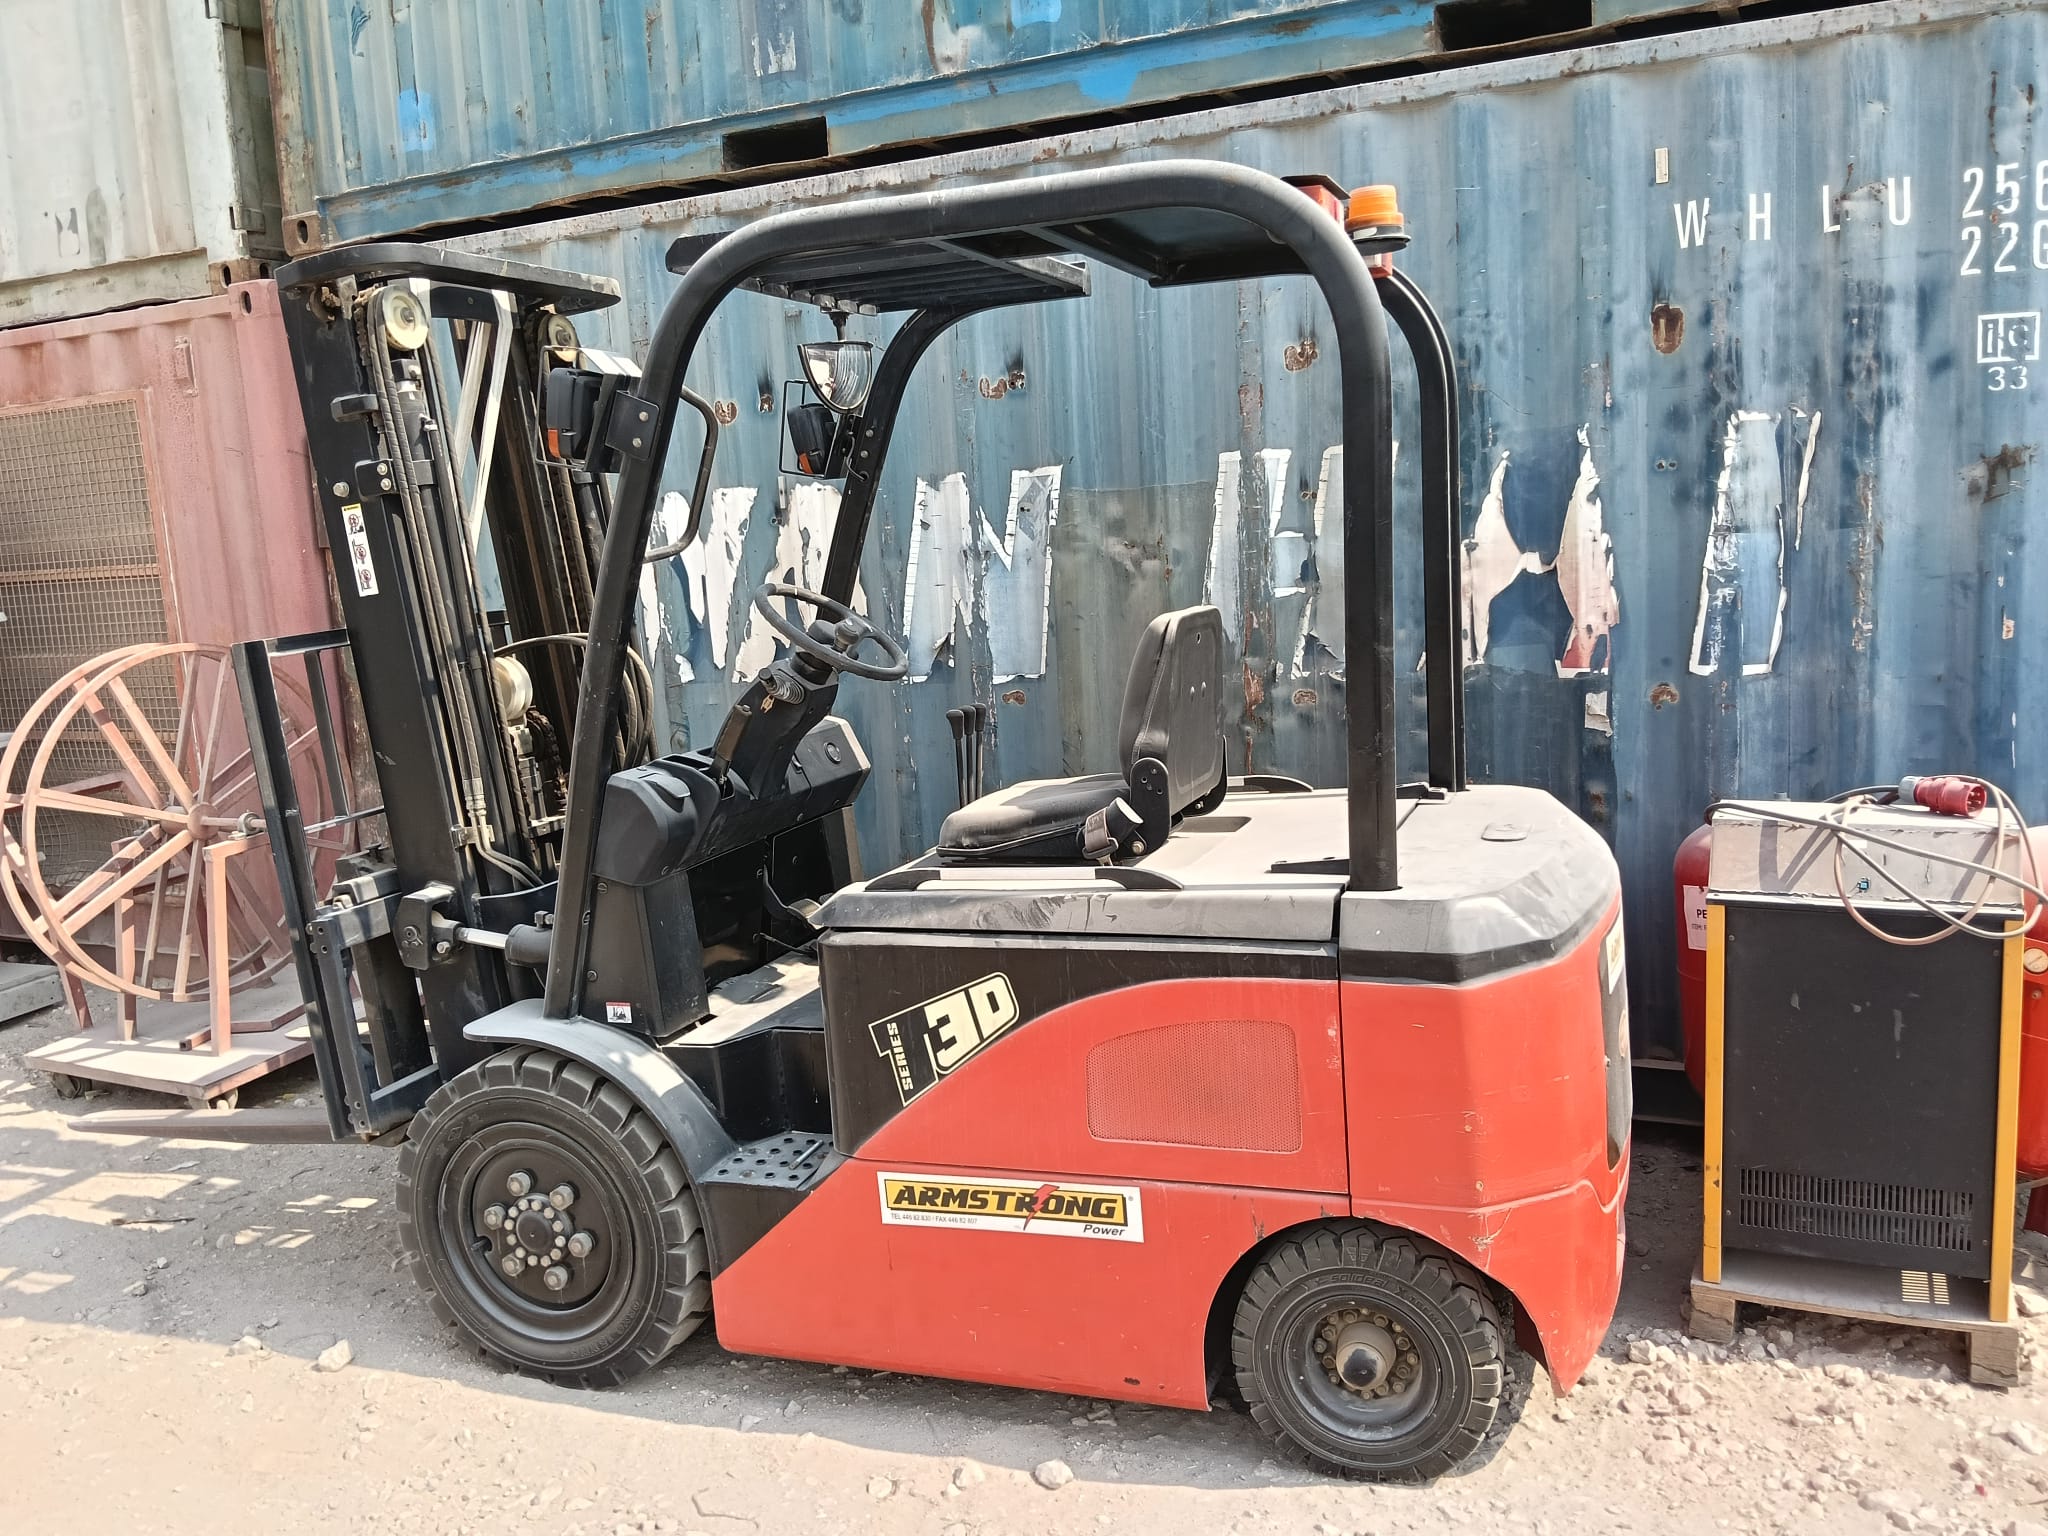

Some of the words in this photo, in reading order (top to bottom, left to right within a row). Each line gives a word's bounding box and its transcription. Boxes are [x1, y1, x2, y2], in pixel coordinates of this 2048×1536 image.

[1987, 365, 2028, 391] 33
[886, 1022, 914, 1091] SERIES
[892, 1184, 1118, 1219] ARMSTRONG
[890, 1212, 901, 1221] TEL
[1083, 1224, 1126, 1237] Power
